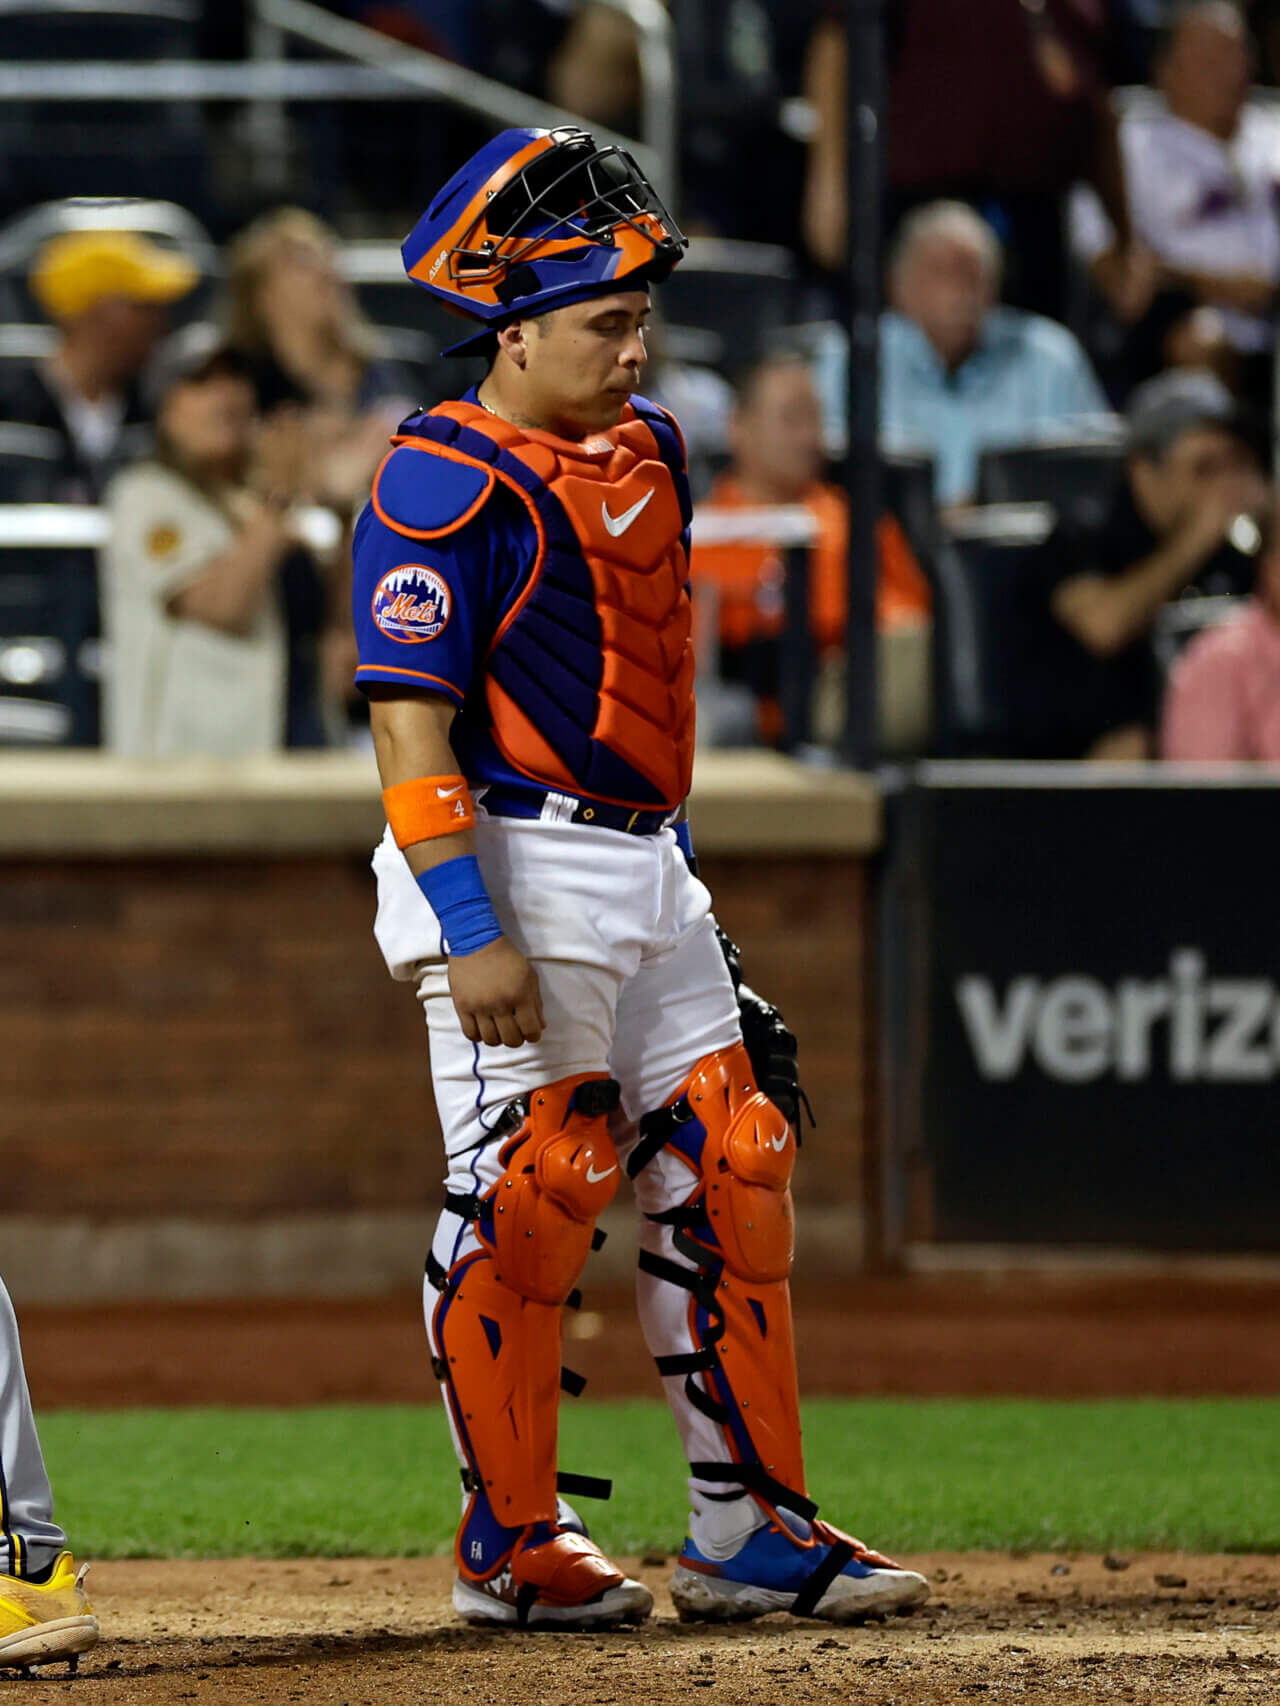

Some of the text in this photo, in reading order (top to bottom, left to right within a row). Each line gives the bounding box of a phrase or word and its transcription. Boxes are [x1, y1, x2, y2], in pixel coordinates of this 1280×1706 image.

[381, 592, 438, 624] Mets
[454, 799, 465, 817] 4
[953, 947, 1280, 1083] veriz
[471, 1540, 483, 1561] FA
